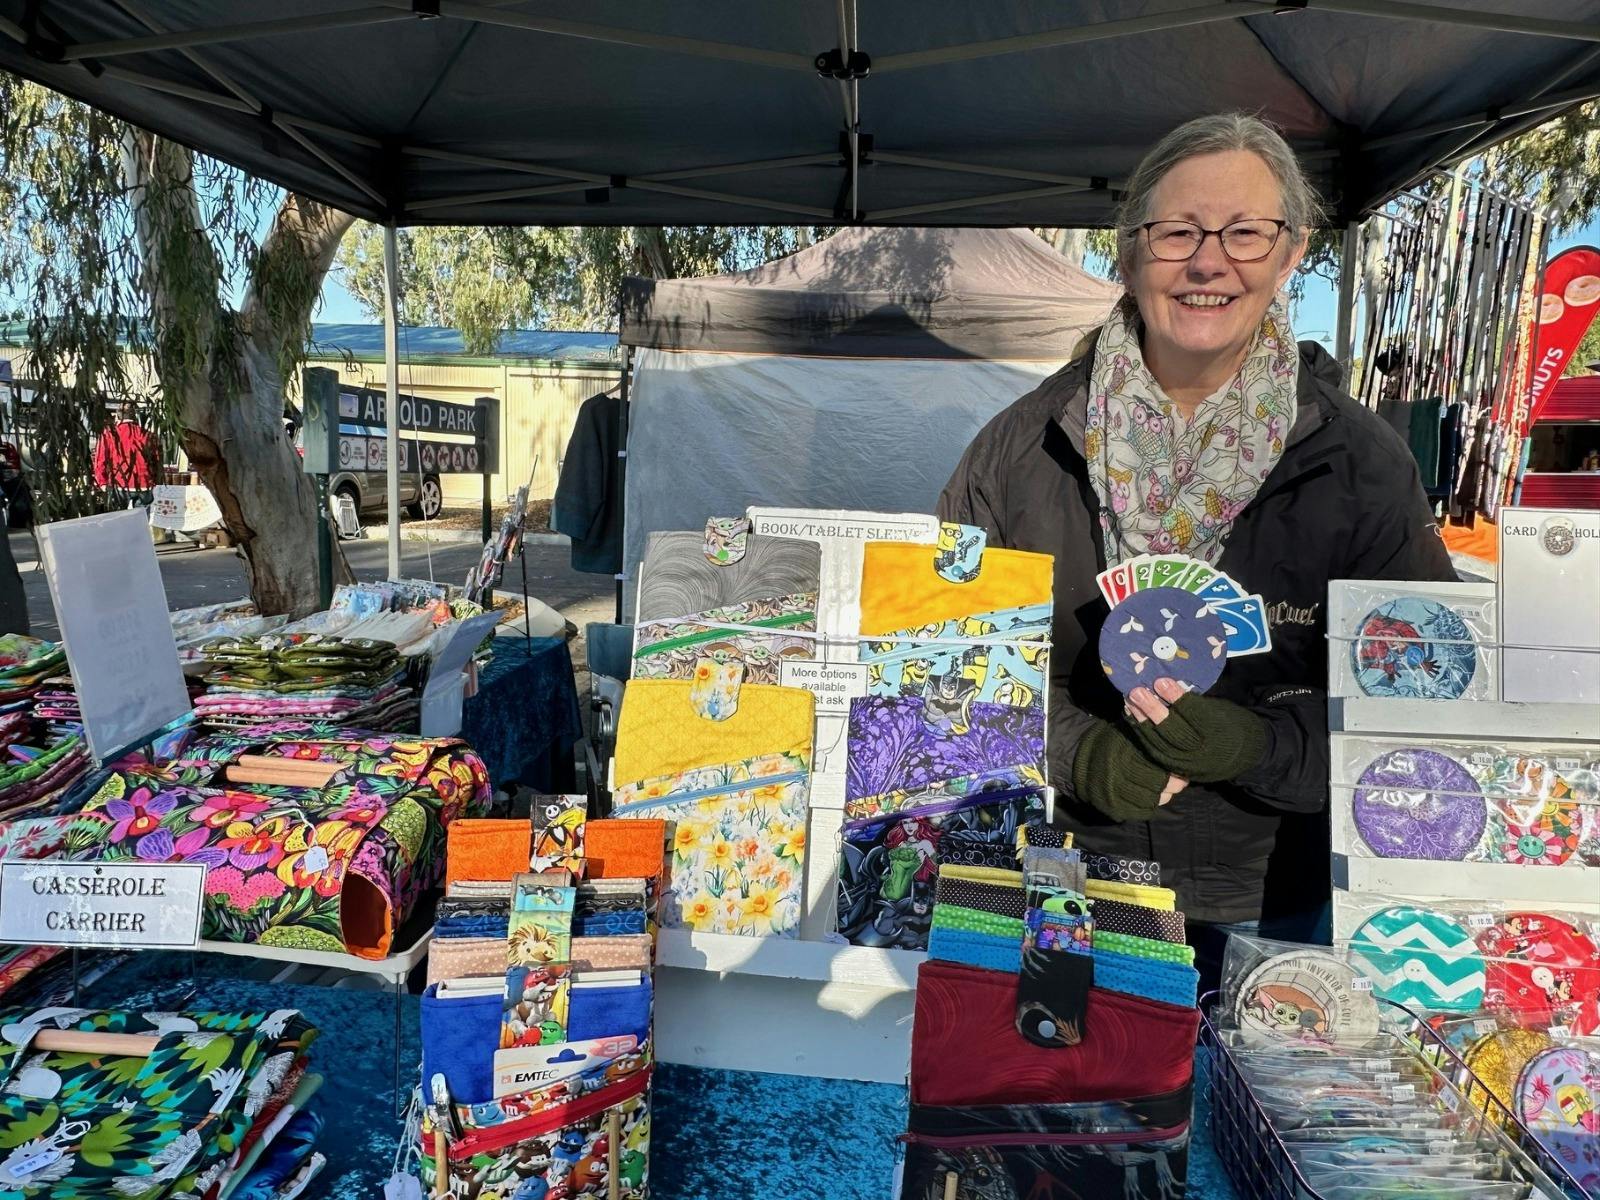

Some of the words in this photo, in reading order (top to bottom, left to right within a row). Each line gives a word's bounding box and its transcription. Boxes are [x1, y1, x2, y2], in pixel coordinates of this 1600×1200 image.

[363, 395, 432, 427] AROLD
[438, 406, 476, 432] PARK
[761, 522, 864, 539] BOOK/TABLET
[866, 527, 929, 540] SLEEVE
[1504, 525, 1537, 536] CARD
[1139, 566, 1150, 581] 2
[1156, 563, 1171, 576] +2
[1242, 603, 1257, 614] 4
[791, 667, 818, 677] More
[820, 669, 857, 681] options
[801, 682, 847, 692] available
[826, 696, 844, 705] ask
[32, 876, 166, 897] CASSEROLE
[46, 911, 146, 932] CARRIER
[514, 1069, 560, 1083] EMTEC
